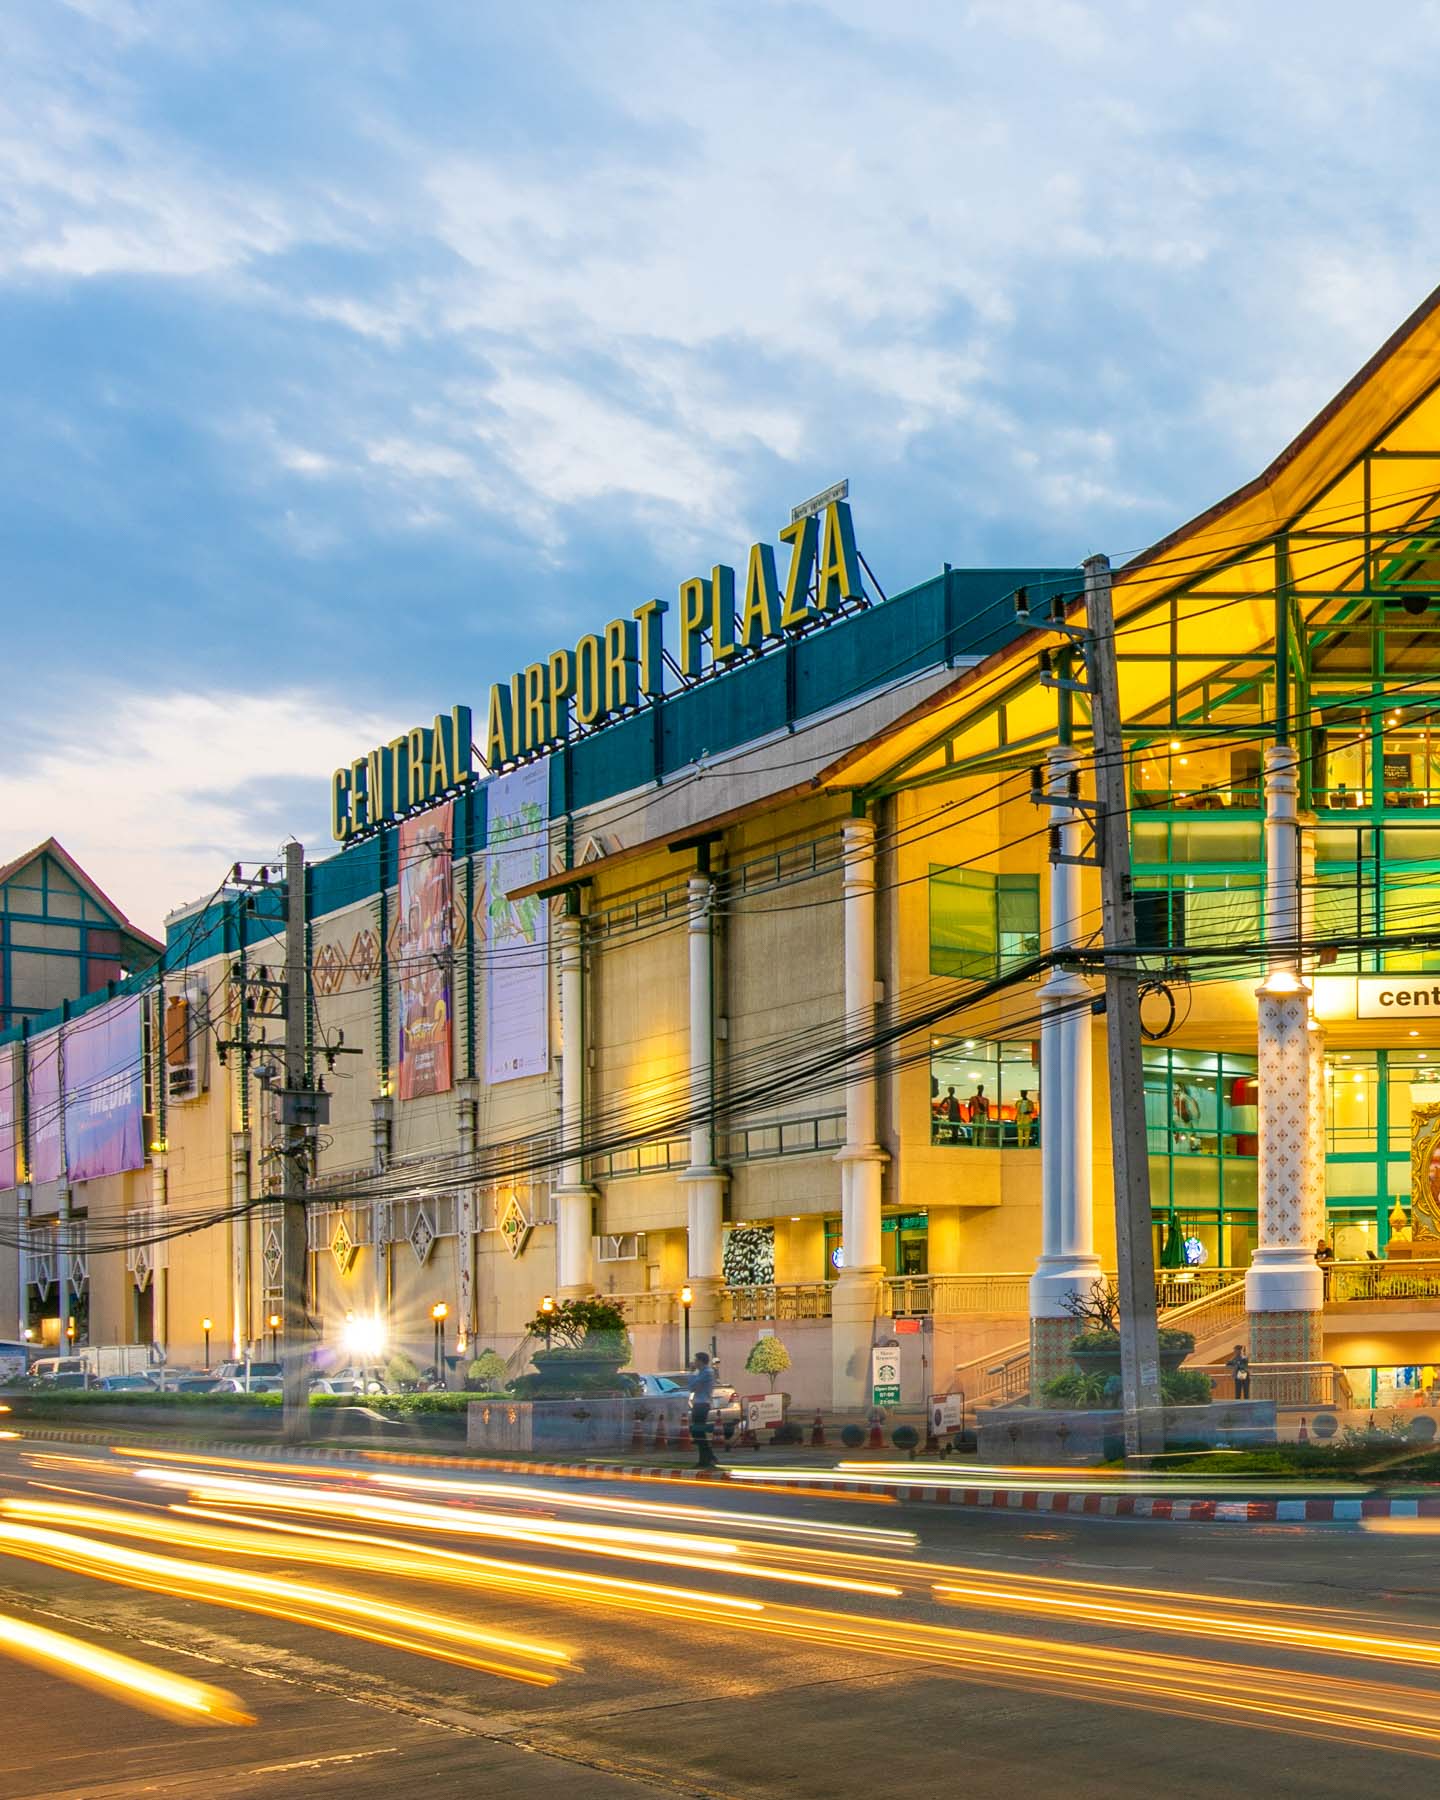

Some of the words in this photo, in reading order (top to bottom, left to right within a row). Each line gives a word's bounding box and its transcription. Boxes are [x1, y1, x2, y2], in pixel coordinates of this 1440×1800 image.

[331, 705, 478, 842] CENTRAL
[486, 598, 668, 770] AIRPORT
[680, 500, 863, 679] PLAZA
